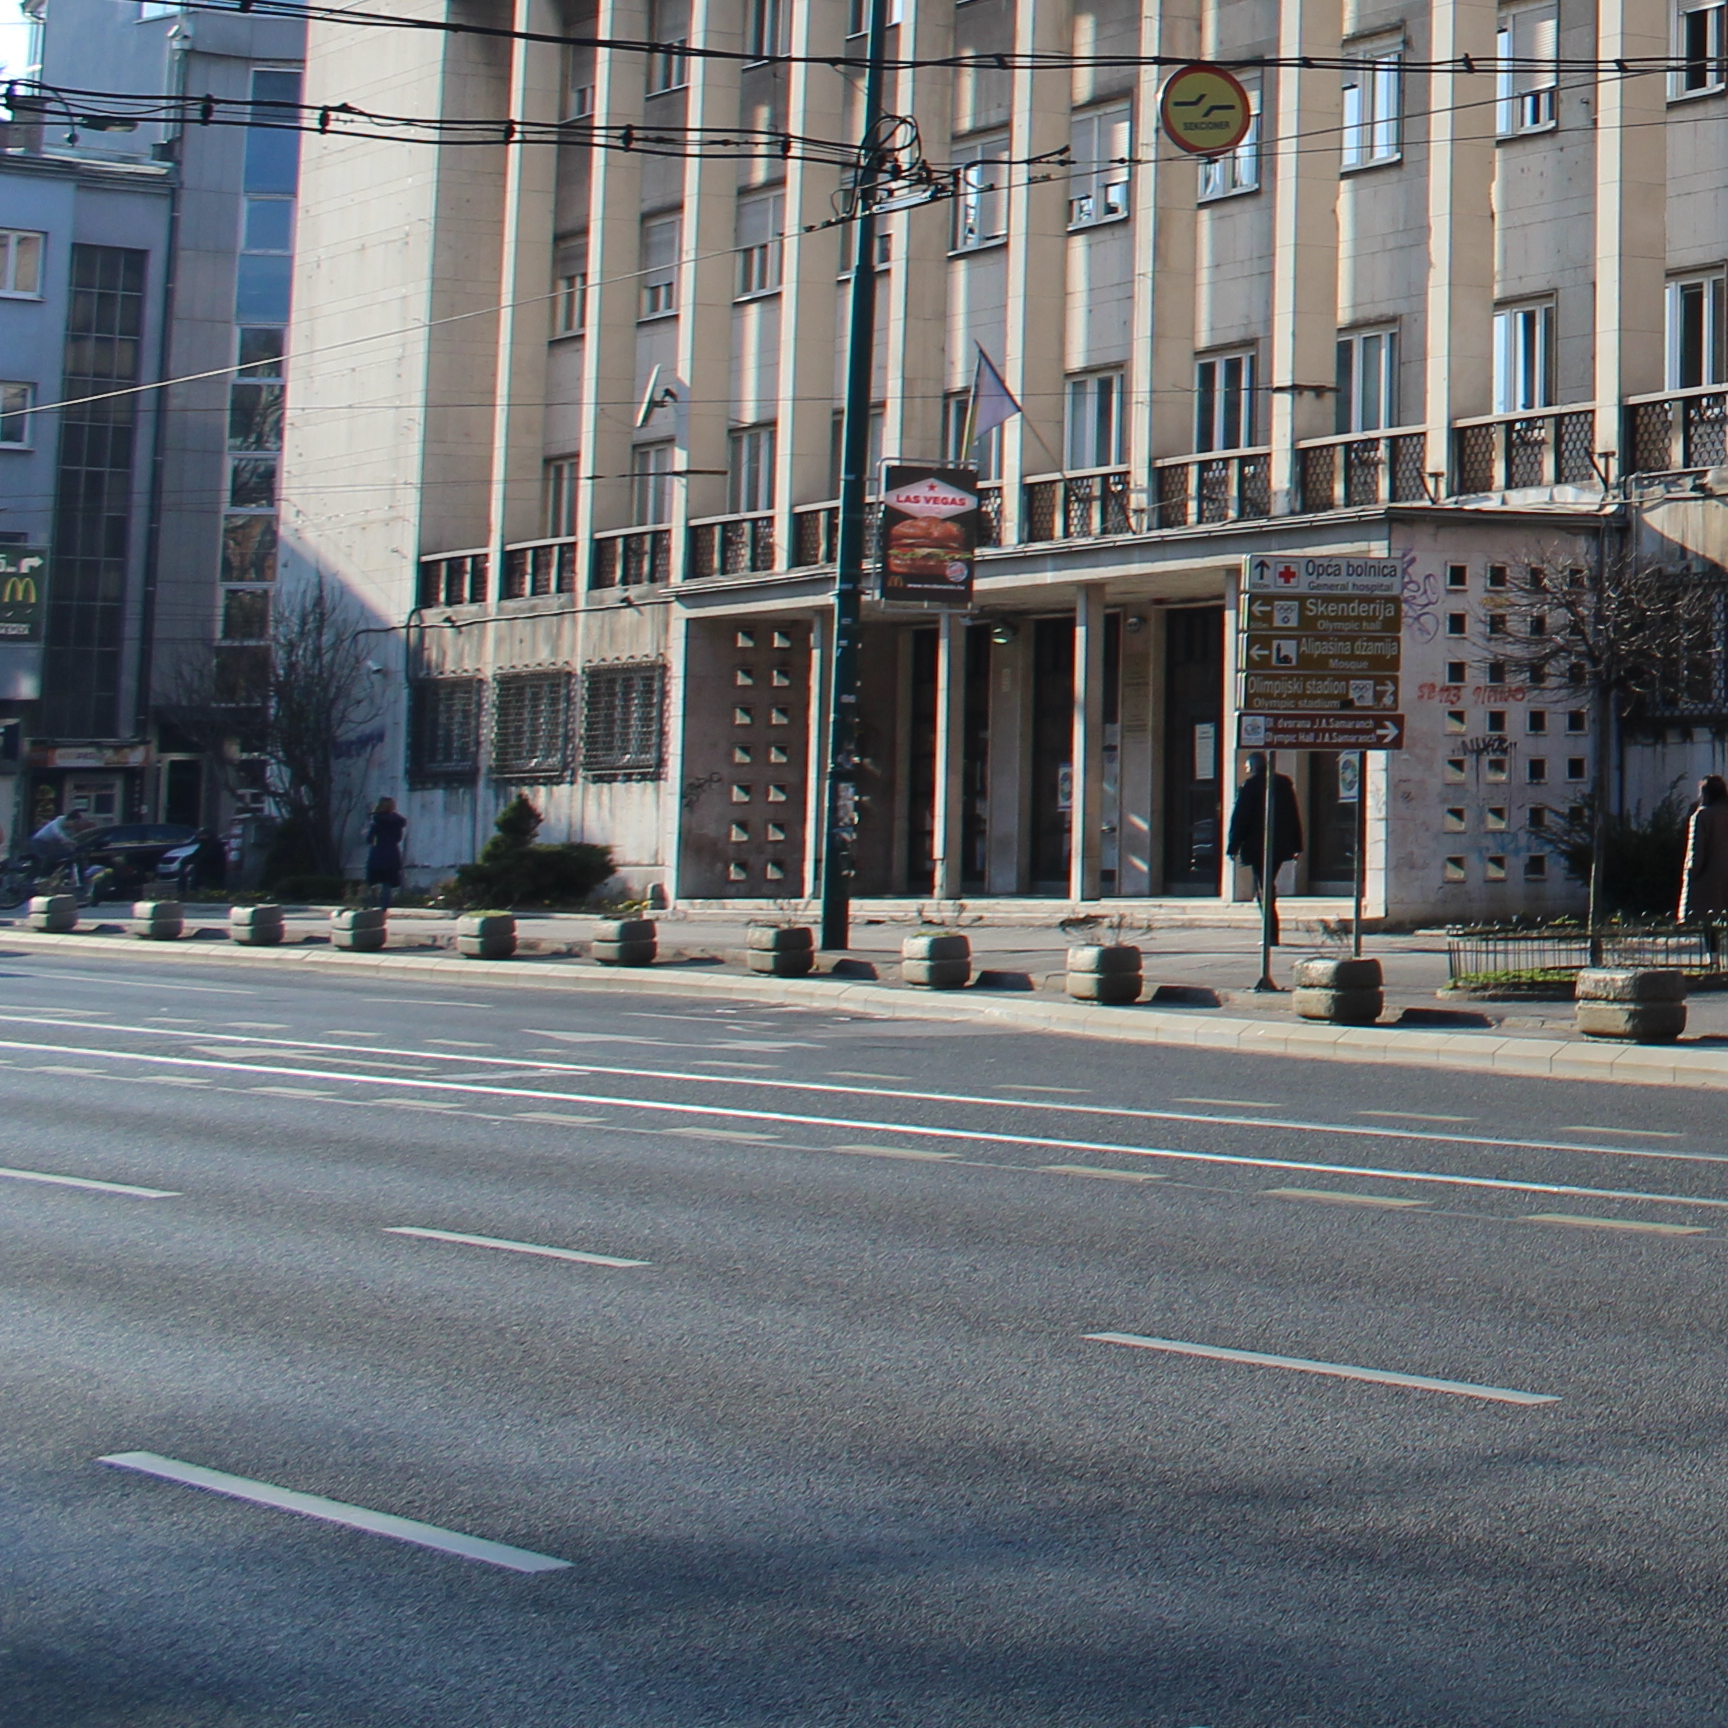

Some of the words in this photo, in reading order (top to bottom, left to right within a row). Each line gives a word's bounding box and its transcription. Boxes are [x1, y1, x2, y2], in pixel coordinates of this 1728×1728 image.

[896, 494, 921, 504] LAS
[924, 495, 967, 506] VEGAS
[1305, 558, 1341, 579] Opća
[1346, 561, 1397, 578] bolnica
[1308, 581, 1349, 592] General
[1352, 582, 1393, 595] hospital
[1305, 599, 1395, 620] Skenderija
[1317, 620, 1358, 632] Olympic
[1362, 620, 1382, 630] hall
[1301, 637, 1350, 658] Alipašina
[1354, 637, 1398, 659] džamija
[1329, 658, 1369, 670] Mosque
[1249, 676, 1303, 697] Olimpijski
[1305, 678, 1346, 695] stadion
[1253, 697, 1295, 710] Olympic
[1298, 697, 1341, 708] stadium
